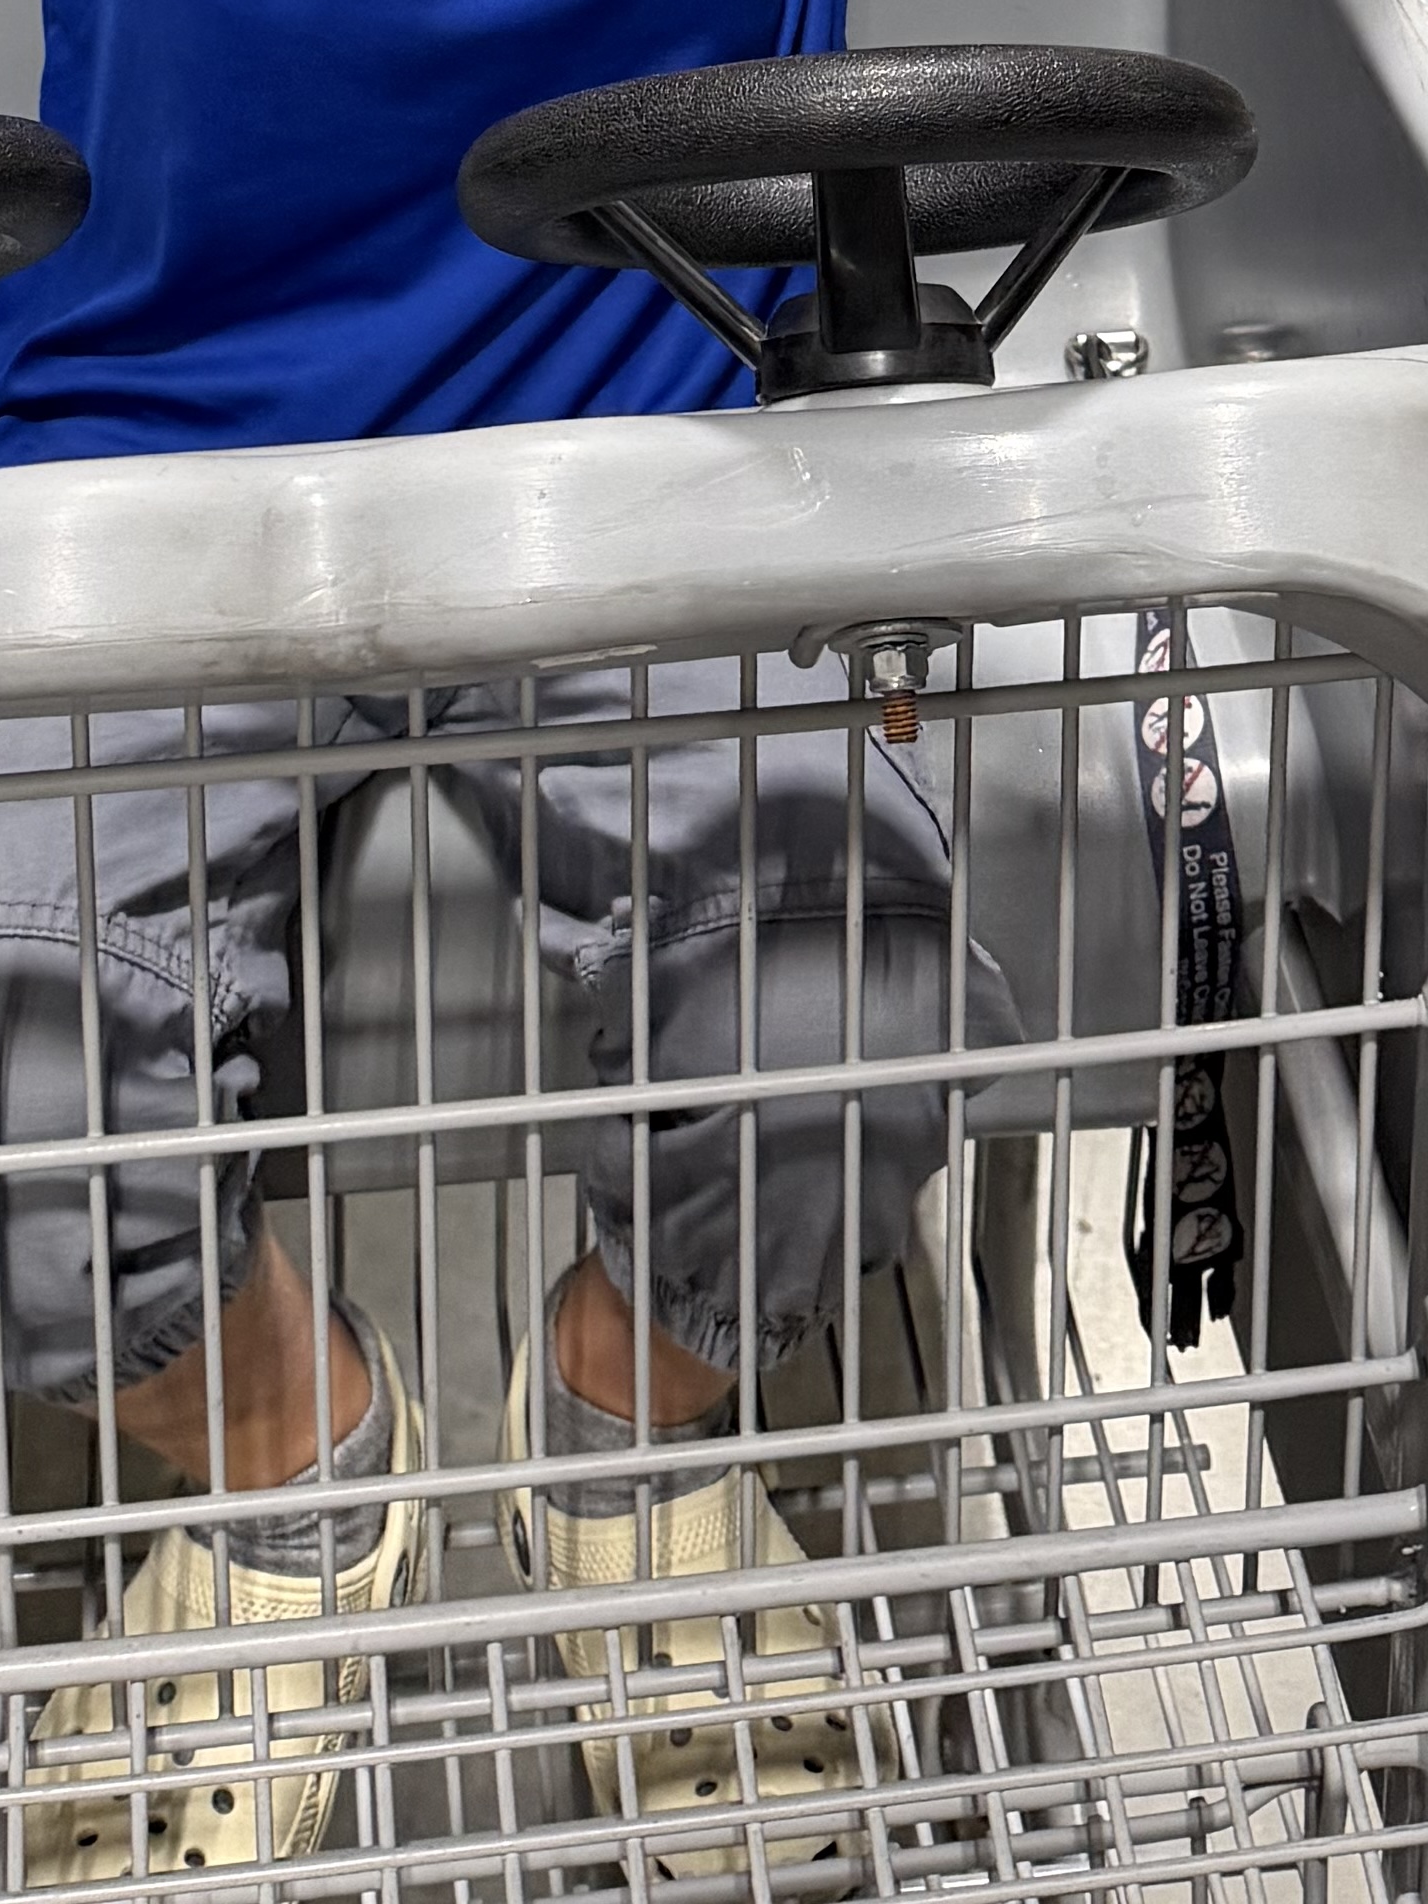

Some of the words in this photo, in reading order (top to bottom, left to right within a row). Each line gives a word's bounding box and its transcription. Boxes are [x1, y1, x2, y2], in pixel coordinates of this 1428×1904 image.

[1182, 844, 1202, 877] Do
[1188, 881, 1209, 923] Not
[1210, 851, 1231, 926] Please
[1193, 925, 1212, 984] Leave
